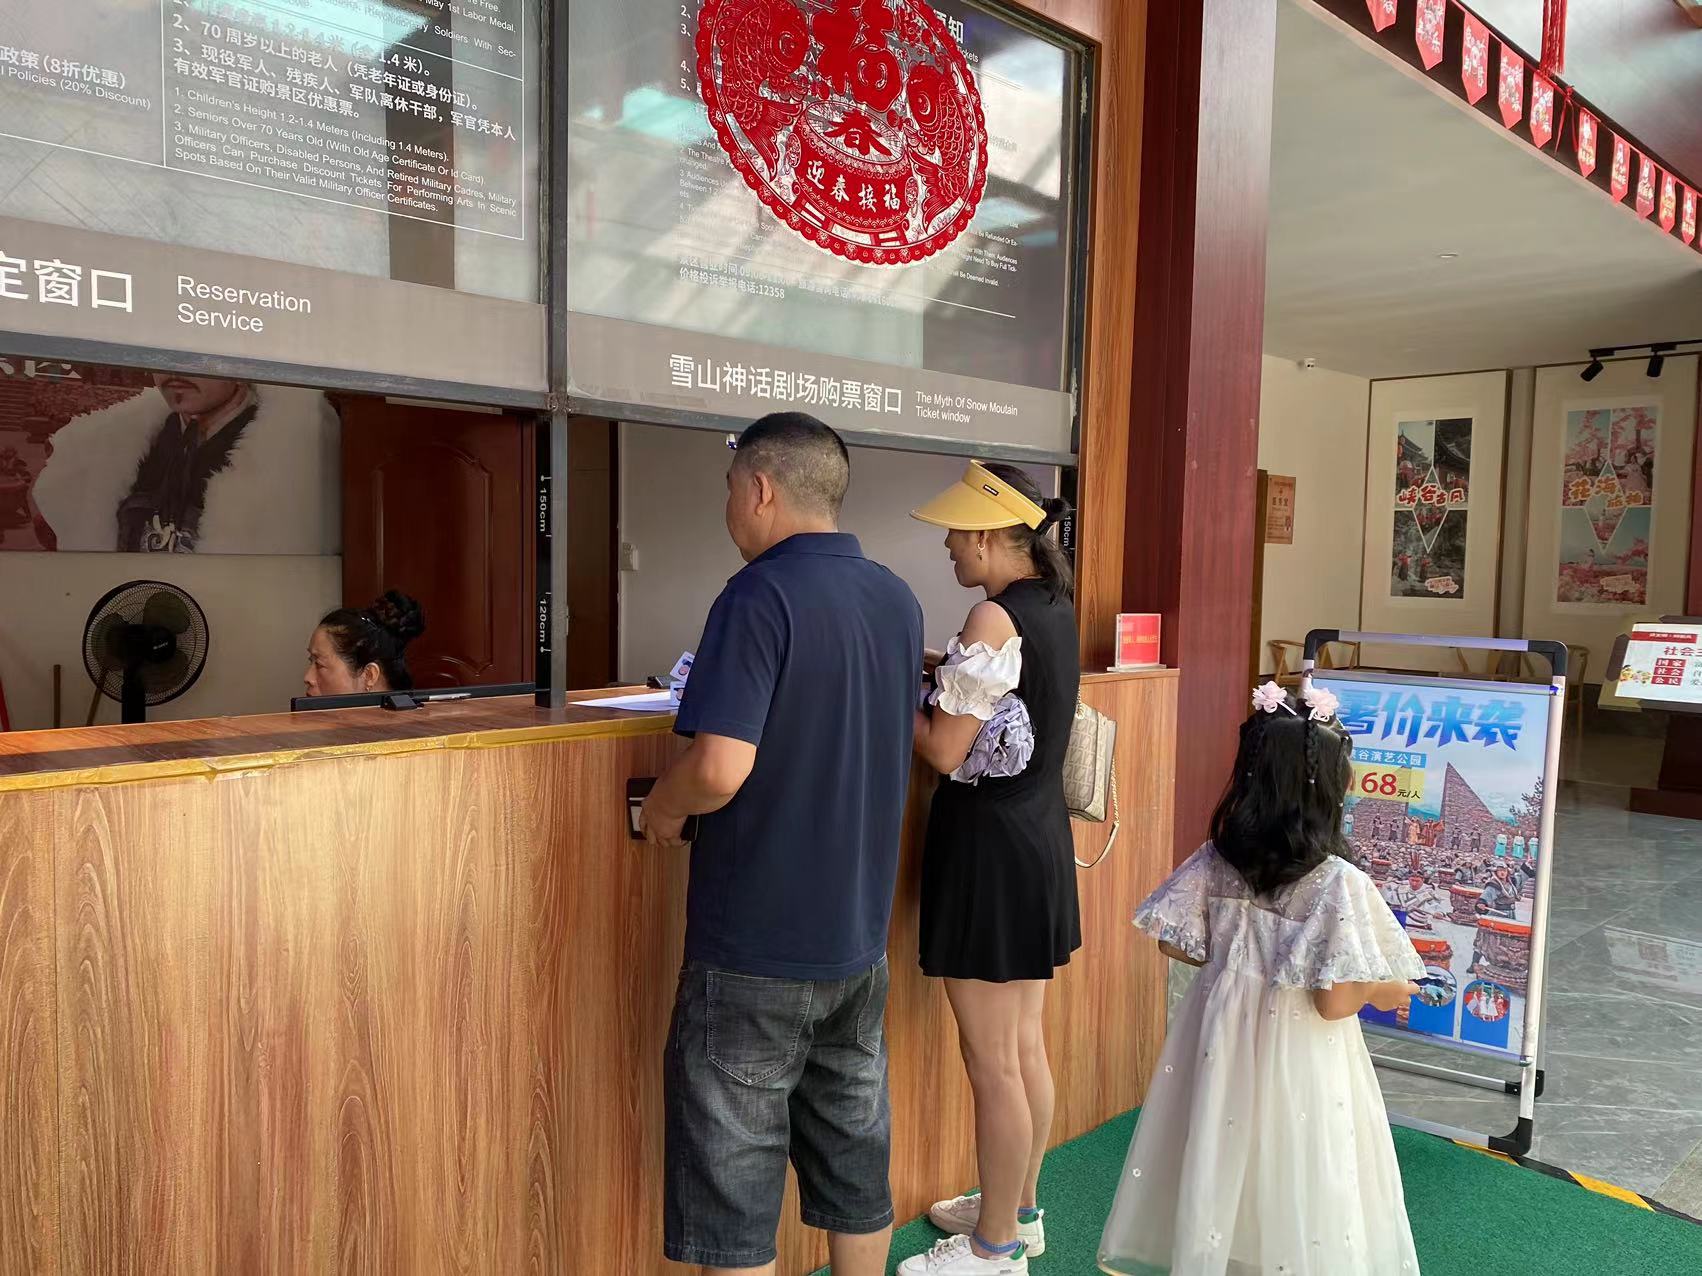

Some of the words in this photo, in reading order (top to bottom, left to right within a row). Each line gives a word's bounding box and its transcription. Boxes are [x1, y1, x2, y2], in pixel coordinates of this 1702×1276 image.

[448, 3, 460, 14] 1st
[462, 8, 487, 22] Labor
[489, 16, 516, 33] Medal.
[434, 25, 468, 43] Soldiers
[474, 38, 492, 51] With
[498, 45, 516, 58] Sec-
[8, 67, 57, 87] Policies
[60, 78, 92, 95] (20%
[95, 87, 152, 111] Discount)
[187, 90, 241, 111] Children's
[243, 105, 277, 120] Height
[280, 112, 313, 129] 1.2-1.4
[316, 121, 349, 137] Meters
[352, 130, 396, 150] (Including
[399, 141, 412, 152] 1.4
[414, 147, 449, 162] Meters).
[188, 106, 229, 125] Seniors
[231, 117, 257, 131] Over
[260, 124, 273, 135] 70
[276, 127, 304, 142] Years
[306, 135, 323, 147] Old
[326, 139, 350, 153] (With
[353, 146, 369, 157] Old
[372, 151, 389, 163] Age
[391, 155, 435, 173] Certificate
[438, 165, 448, 175] Or
[451, 168, 459, 178] Id
[460, 171, 486, 185] Card).
[825, 112, 893, 156] 春
[188, 124, 227, 142] Military
[276, 144, 319, 162] Disabled
[366, 165, 384, 177] And
[387, 170, 419, 184] Retired
[421, 177, 451, 193] Military
[488, 192, 517, 206] Military
[688, 148, 700, 157] The
[175, 135, 217, 152] Officers
[223, 145, 244, 158] Can
[250, 151, 298, 170] Purchase
[303, 163, 345, 180] Discount
[350, 173, 382, 188] Tickets
[387, 182, 402, 193] For
[407, 186, 454, 205] Performing
[457, 197, 473, 208] Arts
[477, 202, 485, 211] In
[490, 204, 517, 217] Scenic
[175, 148, 206, 164] Spots
[209, 155, 242, 171] Based
[246, 162, 262, 175] On
[264, 166, 290, 181] Their
[293, 172, 316, 186] Valid
[319, 178, 352, 195] Military
[355, 186, 385, 200] Officer
[387, 193, 439, 212] Certificates.
[806, 159, 901, 213] 迎春接福
[176, 275, 312, 314] Reservation
[176, 303, 264, 333] Service
[669, 353, 902, 415] 雪山神话剧场购票窗口
[916, 391, 932, 403] The
[933, 394, 954, 409] Myth
[955, 396, 965, 409] Of
[966, 399, 988, 413] Snow
[916, 406, 940, 420] Ticket
[941, 410, 971, 424] window
[539, 488, 547, 532] 150cm
[1063, 515, 1072, 547] 150cm
[539, 599, 547, 642] 120cm
